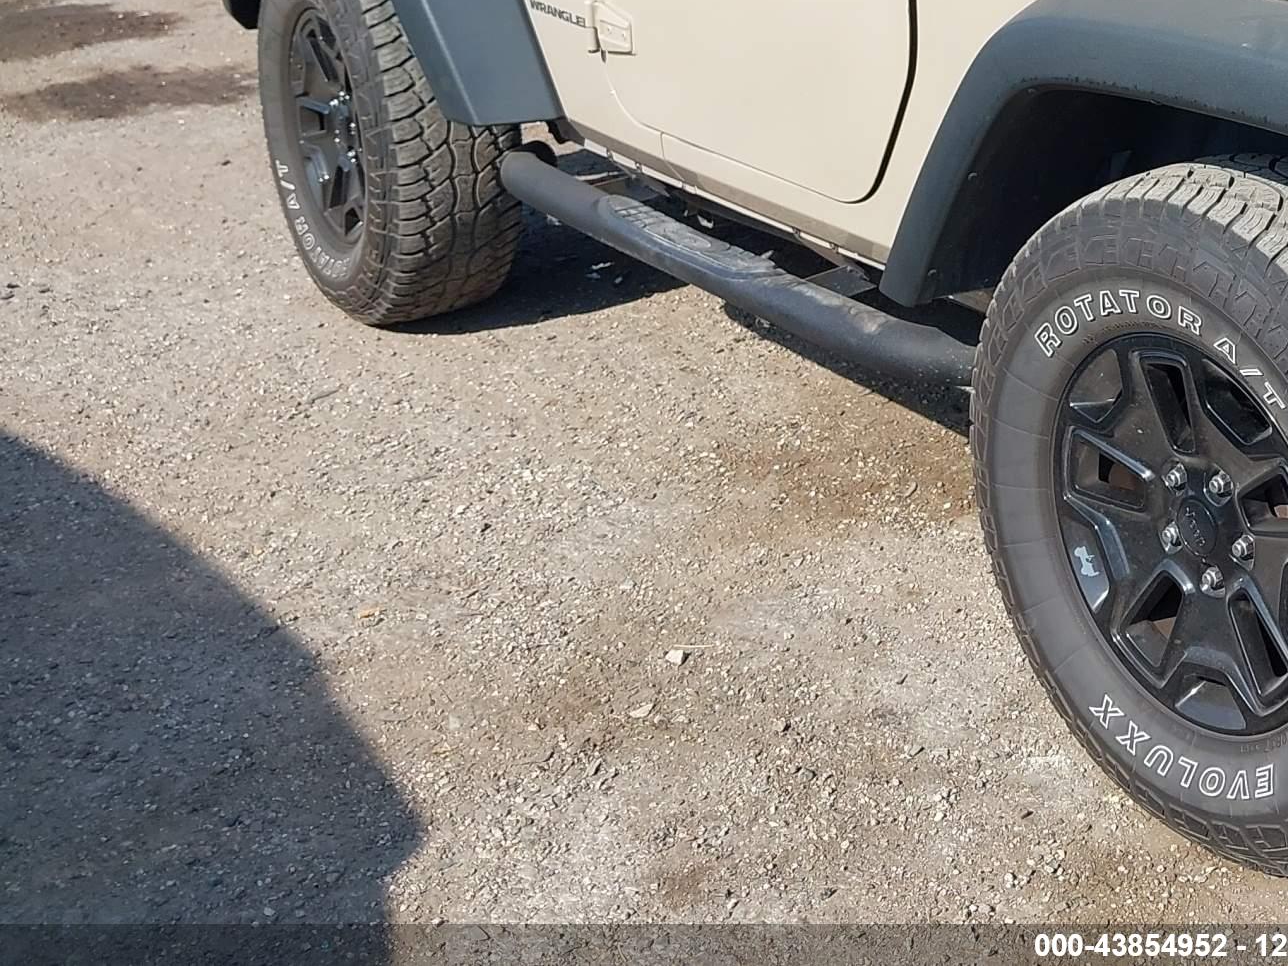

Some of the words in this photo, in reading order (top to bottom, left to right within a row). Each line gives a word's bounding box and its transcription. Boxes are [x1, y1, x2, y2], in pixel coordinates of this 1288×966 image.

[1034, 289, 1203, 358] ROTATOR
[1213, 337, 1287, 410] A/T
[1088, 693, 1275, 801] EVOLUXX
